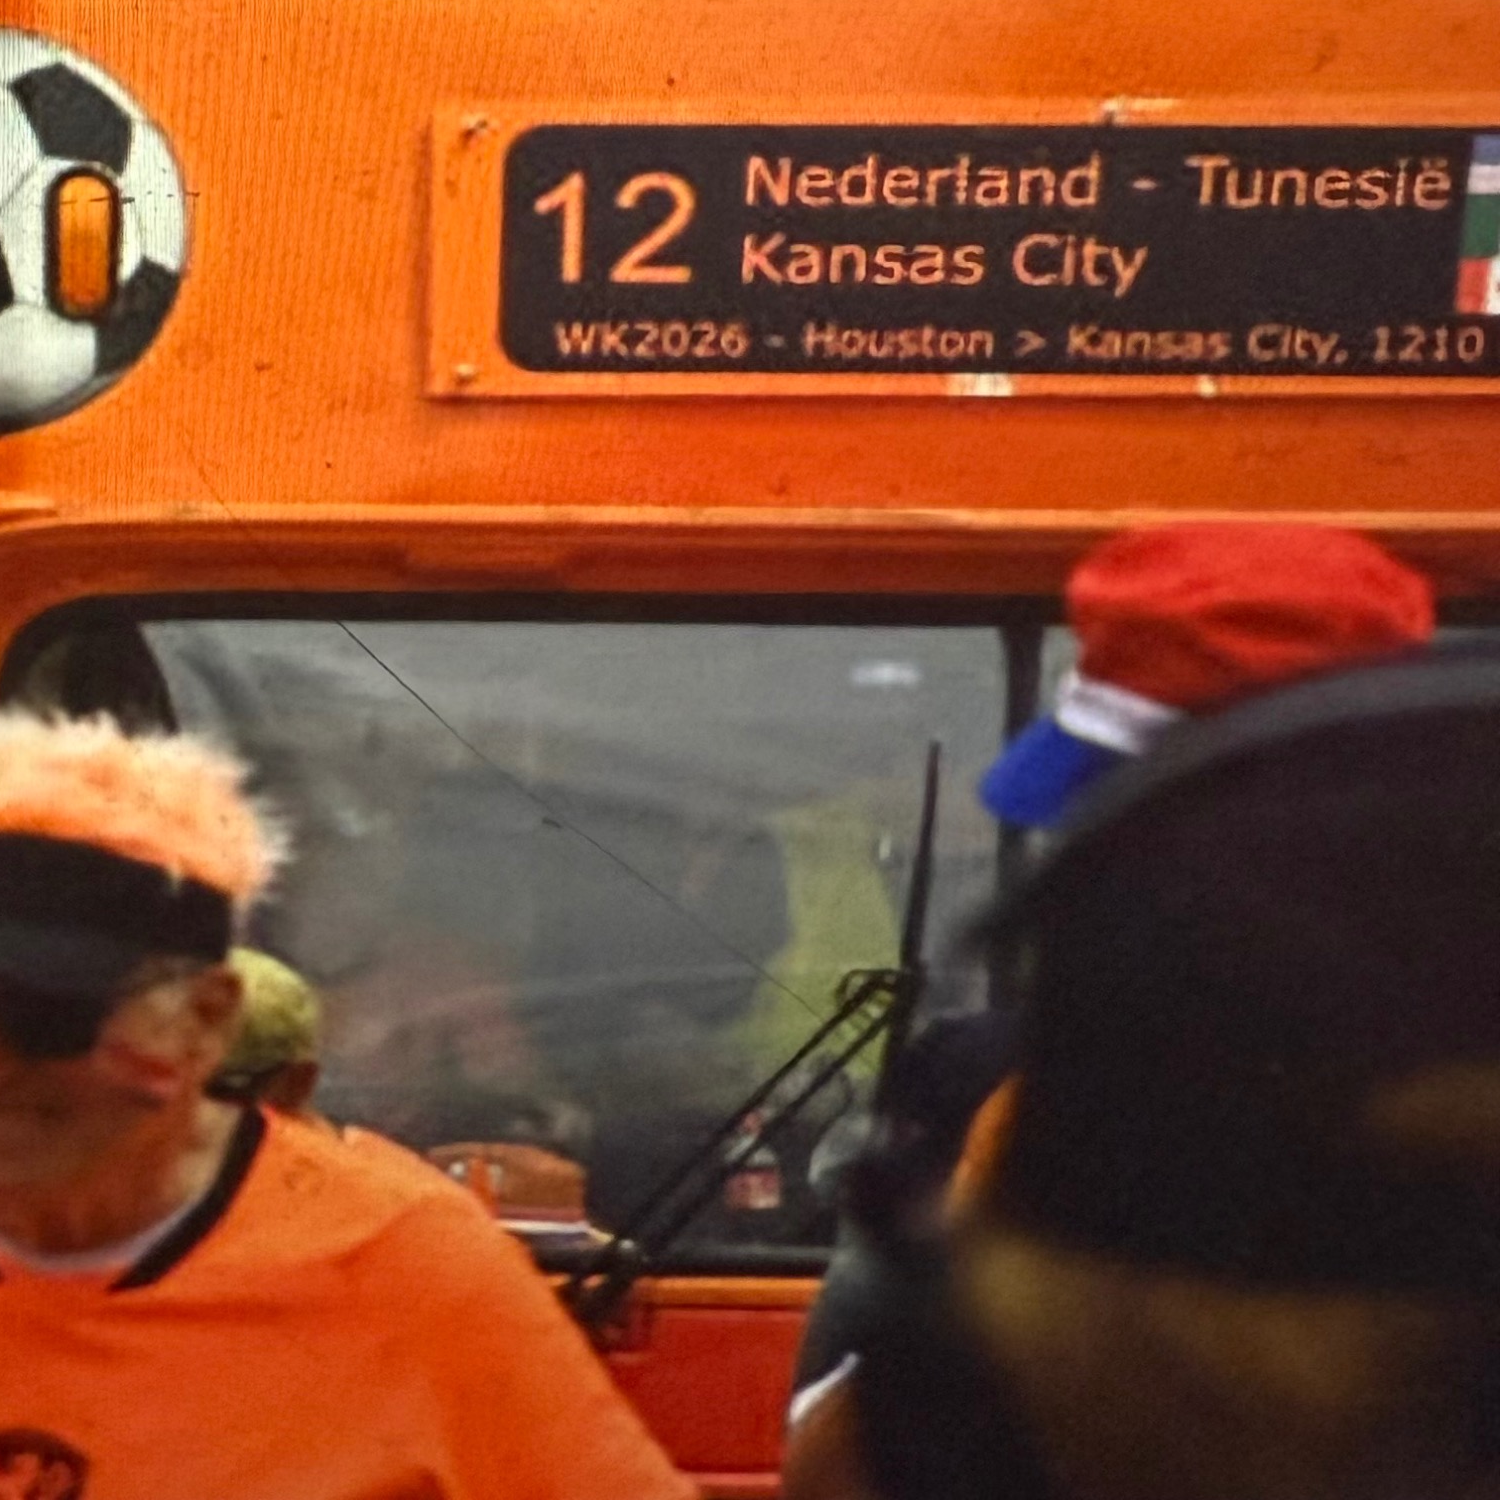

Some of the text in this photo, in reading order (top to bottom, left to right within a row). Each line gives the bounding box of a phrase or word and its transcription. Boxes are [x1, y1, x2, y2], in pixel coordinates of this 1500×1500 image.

[745, 153, 1102, 209] Nederland
[1186, 152, 1453, 210] Tunesië
[534, 171, 696, 286] 12
[742, 233, 1148, 298] Kansas City
[555, 320, 750, 359] WK2026
[803, 322, 994, 360] Houston
[1067, 324, 1230, 361] Kansas
[1373, 325, 1486, 363] 1210
